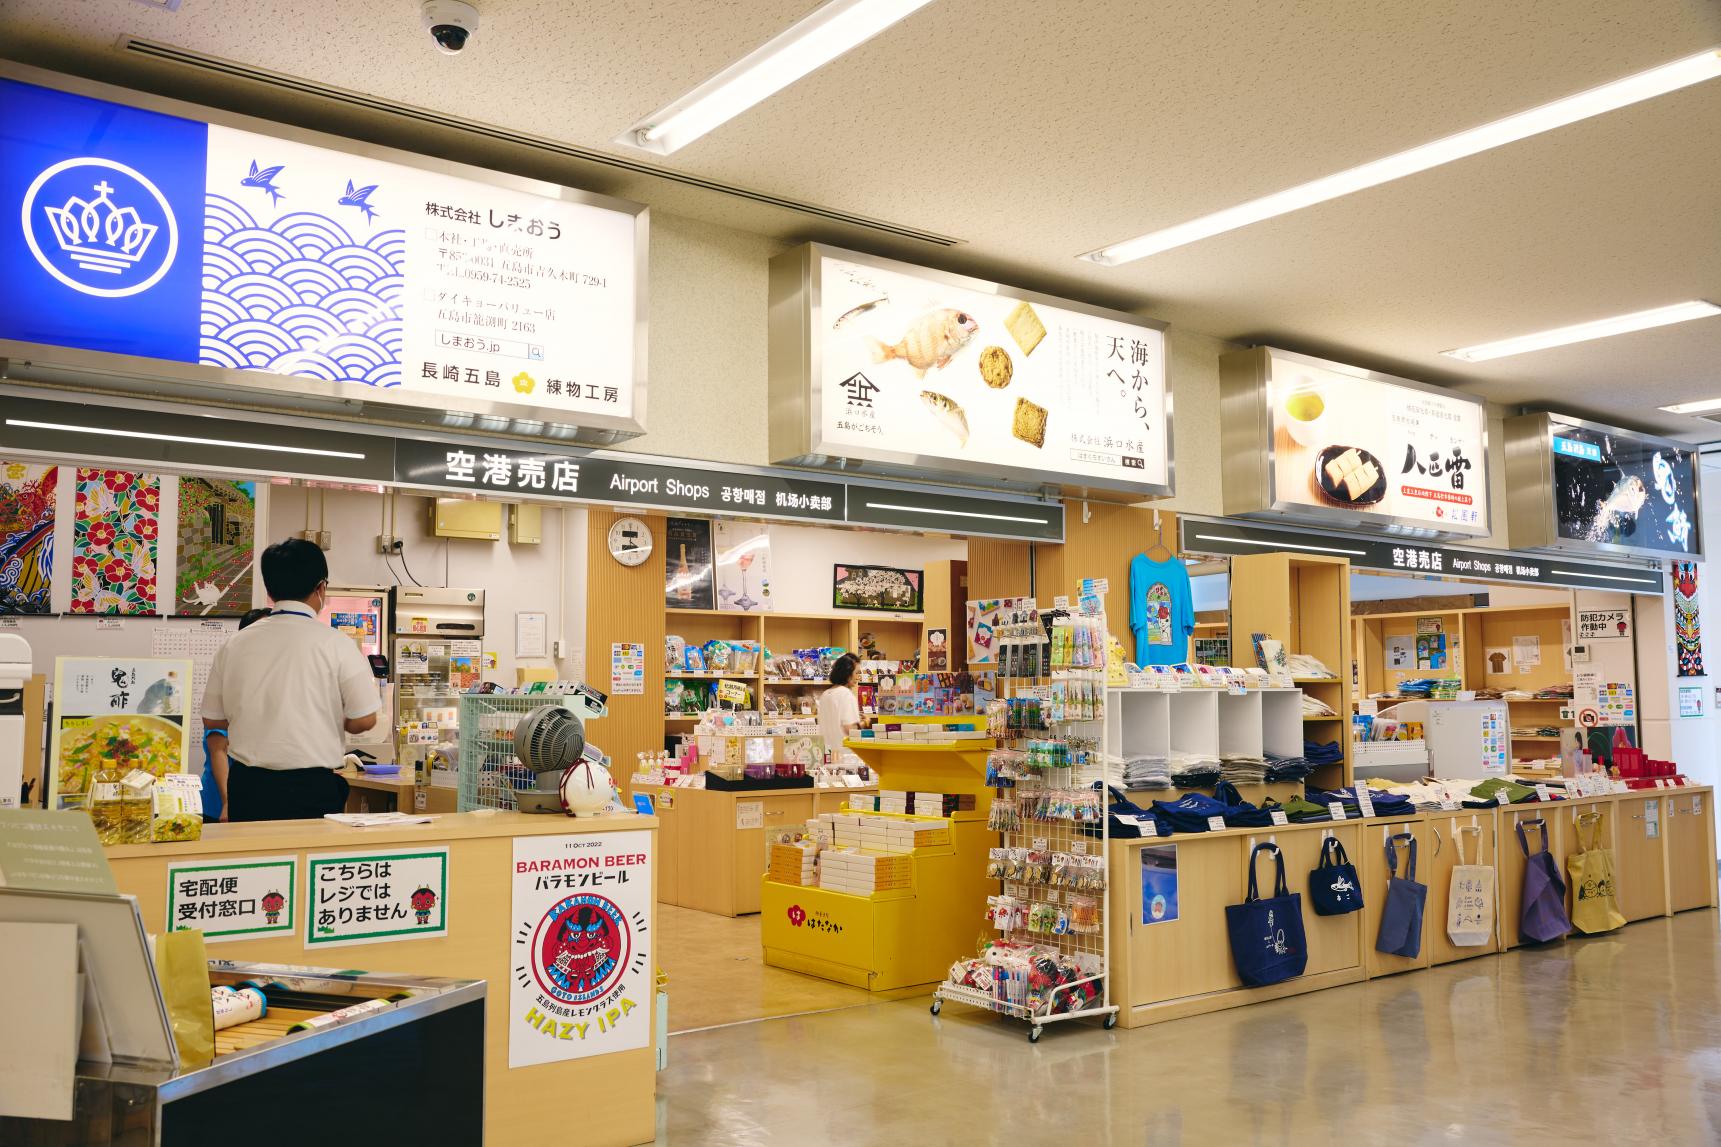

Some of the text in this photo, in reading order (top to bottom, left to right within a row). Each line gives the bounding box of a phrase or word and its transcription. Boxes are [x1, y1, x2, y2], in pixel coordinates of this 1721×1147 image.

[425, 201, 561, 240] 株式会社 しまおう
[582, 274, 608, 289] 729-1
[511, 320, 537, 334] 2163
[441, 333, 500, 353] しまおう.jp
[1106, 335, 1127, 397] 天へ。
[421, 362, 619, 403] 長崎五島 練物工房
[1131, 339, 1150, 431] 海から、
[1104, 436, 1146, 454] 浜口水産
[445, 449, 832, 511] 空港売店 Airport Shops 공항매점 机场小卖部
[1392, 547, 1442, 571] 空港売店
[1452, 558, 1472, 572] Airport
[1474, 559, 1491, 574] Shops
[1580, 612, 1625, 623] 防犯カメラ
[1580, 622, 1607, 632] 作動中
[319, 861, 392, 883] こちらは
[516, 853, 647, 874] BARAMON BEER
[179, 876, 239, 898] 宅配便
[535, 870, 630, 891] バラモンビール
[319, 883, 392, 905] レジでは
[177, 898, 257, 921] 受付窓口
[317, 902, 408, 926] ありません
[807, 917, 843, 934] はたなか
[535, 983, 626, 1017] 五島列島産レモングラス使用
[550, 985, 605, 1001] GOTO ISLANDS
[525, 997, 639, 1041] HAZY IPA
